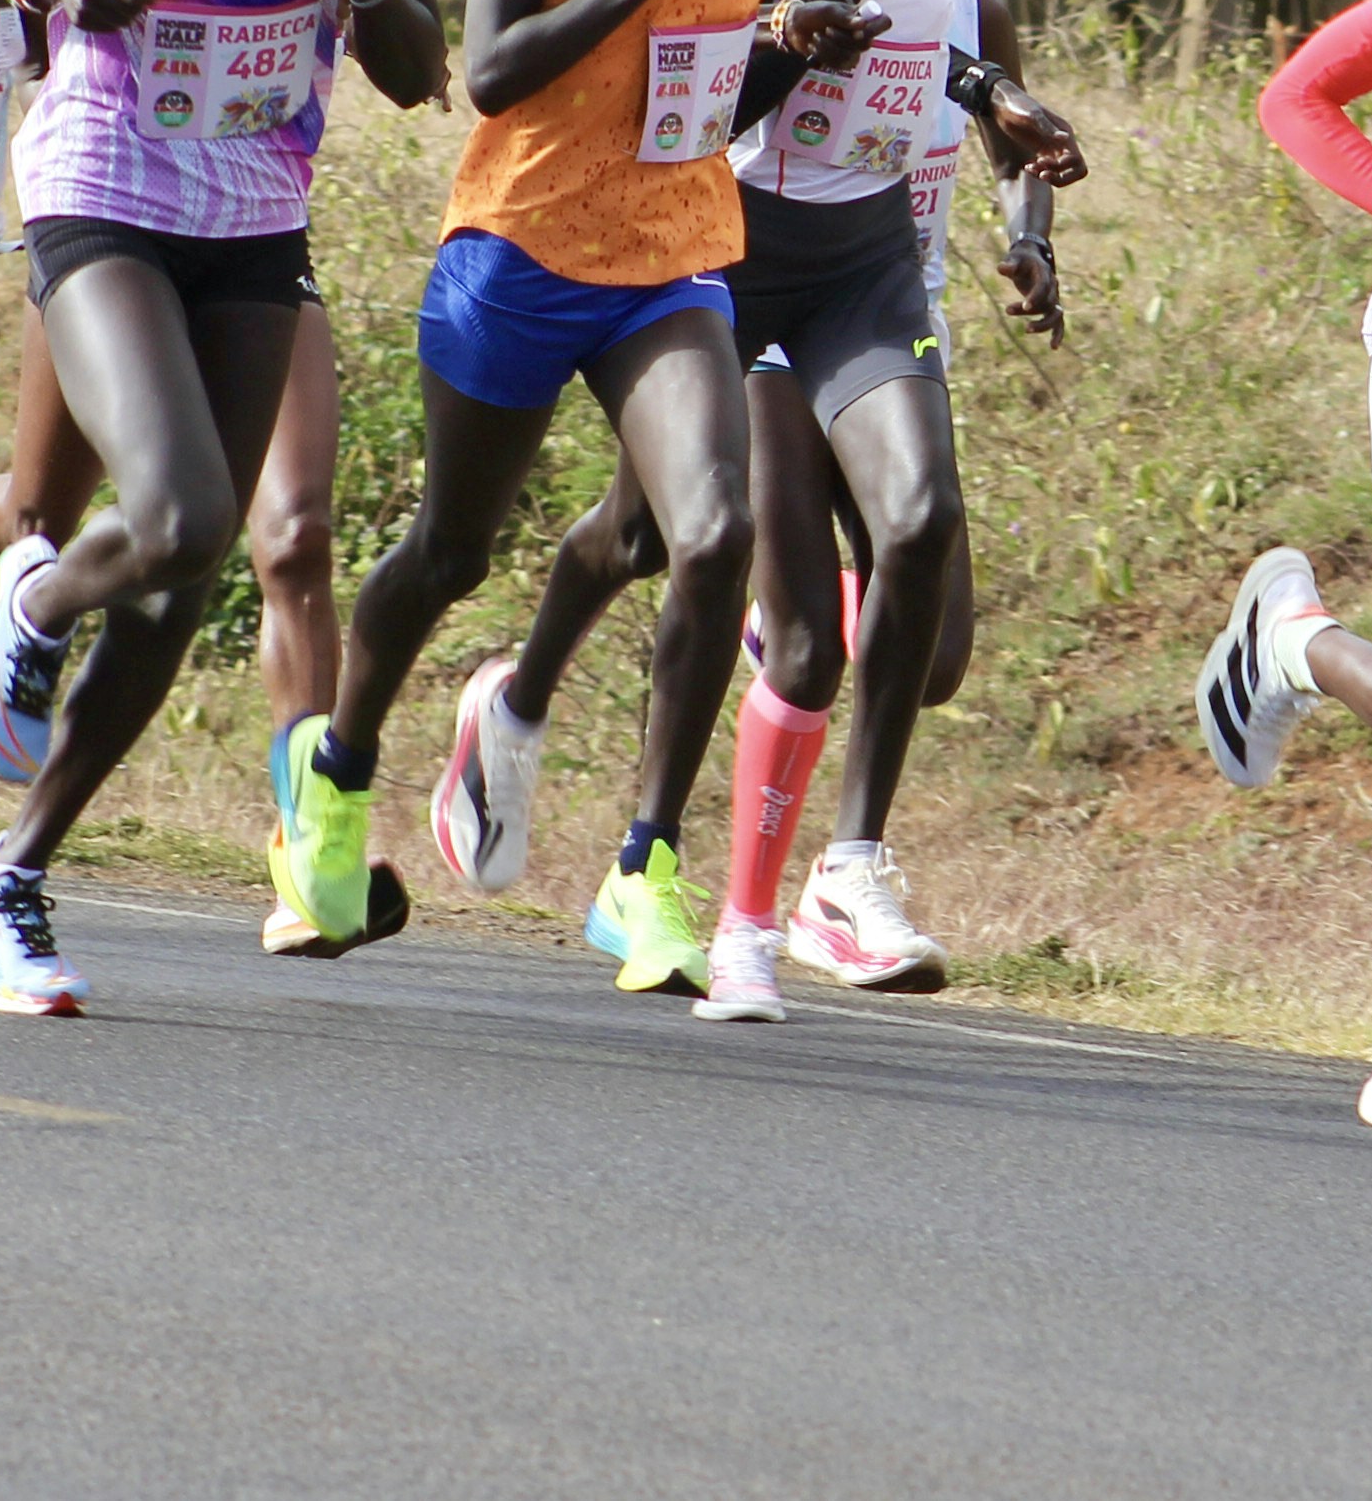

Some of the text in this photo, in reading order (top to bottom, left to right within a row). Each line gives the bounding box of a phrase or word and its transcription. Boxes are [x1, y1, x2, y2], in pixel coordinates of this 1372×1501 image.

[155, 27, 206, 44] HALF
[216, 13, 316, 44] RABECCA
[226, 42, 298, 80] 482
[657, 50, 695, 67] HALF
[866, 57, 932, 80] MONICA
[708, 58, 746, 97] 495
[865, 84, 923, 117] 424
[910, 187, 939, 218] 21
